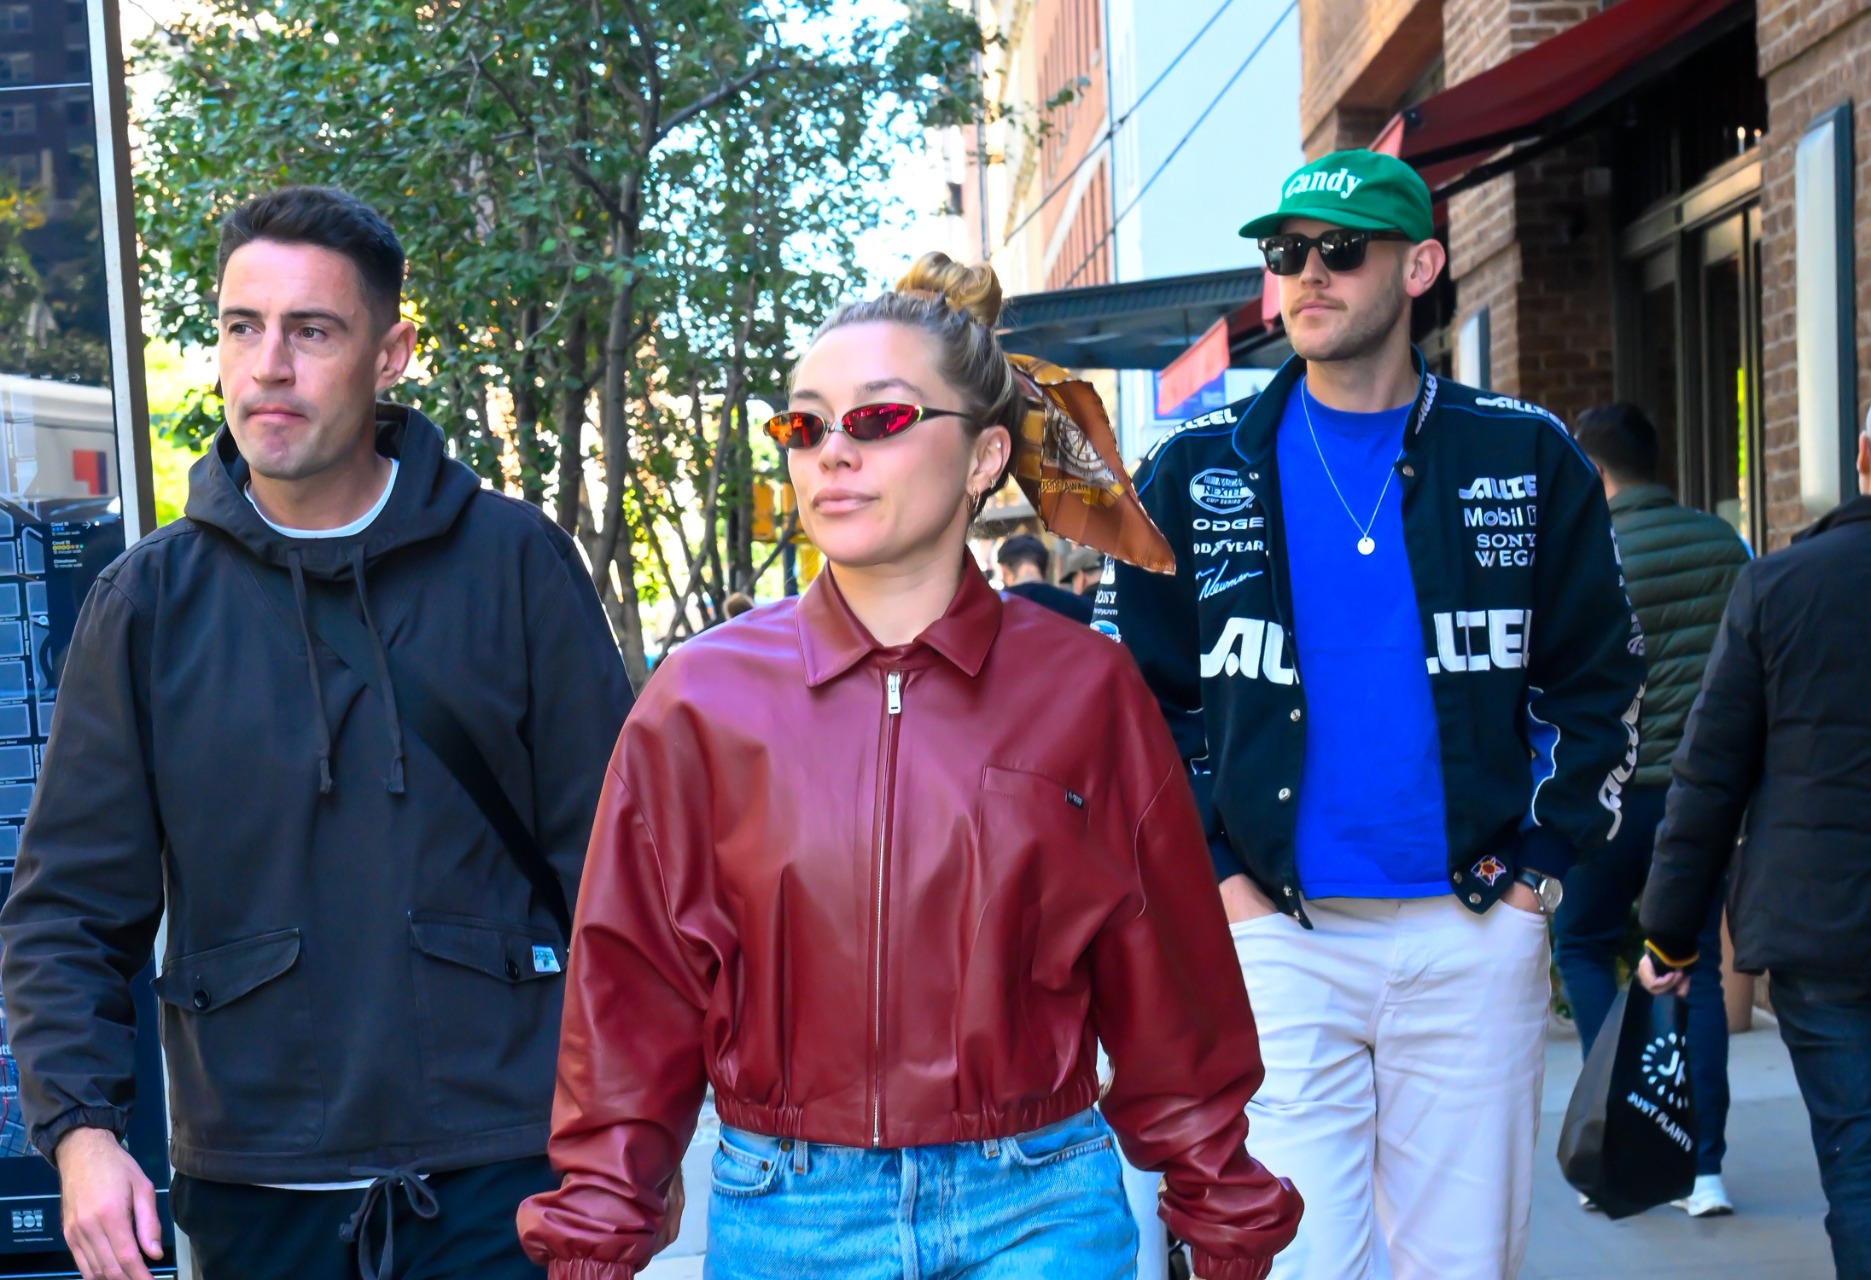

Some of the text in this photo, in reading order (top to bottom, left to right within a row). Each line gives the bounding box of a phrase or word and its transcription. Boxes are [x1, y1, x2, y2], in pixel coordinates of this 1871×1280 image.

[1285, 167, 1363, 199] Candy
[1147, 407, 1238, 461] ALLTEL
[1464, 506, 1524, 527] Mobil
[1477, 533, 1537, 549] SONY
[1627, 1091, 1659, 1117] JUST
